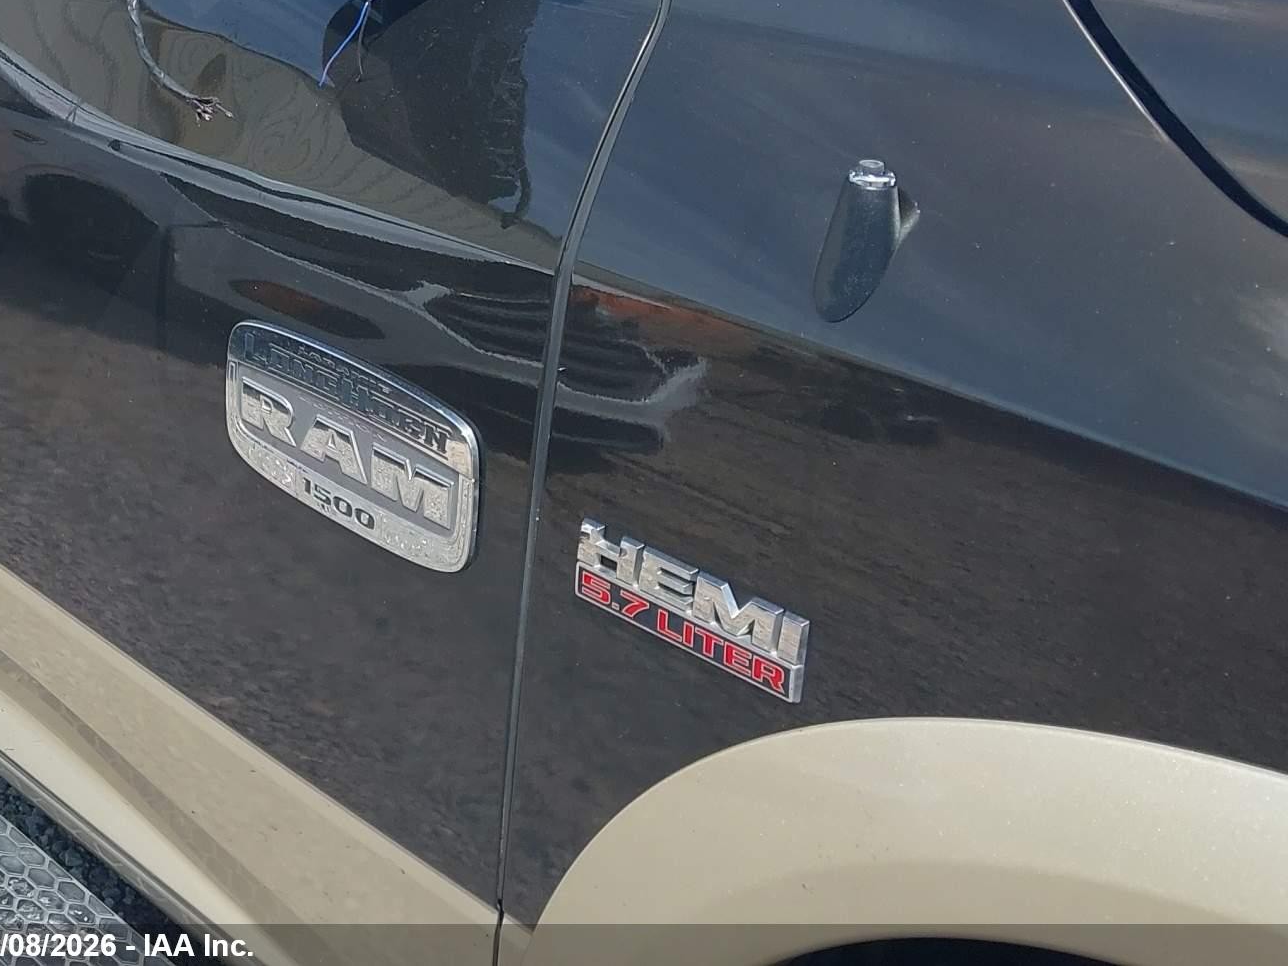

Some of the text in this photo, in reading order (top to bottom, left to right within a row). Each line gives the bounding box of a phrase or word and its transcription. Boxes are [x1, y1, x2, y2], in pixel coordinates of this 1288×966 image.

[240, 376, 455, 531] RAM
[301, 477, 376, 531] 1500
[577, 517, 810, 665] HEMI
[581, 570, 786, 695] 5.7 LITER
